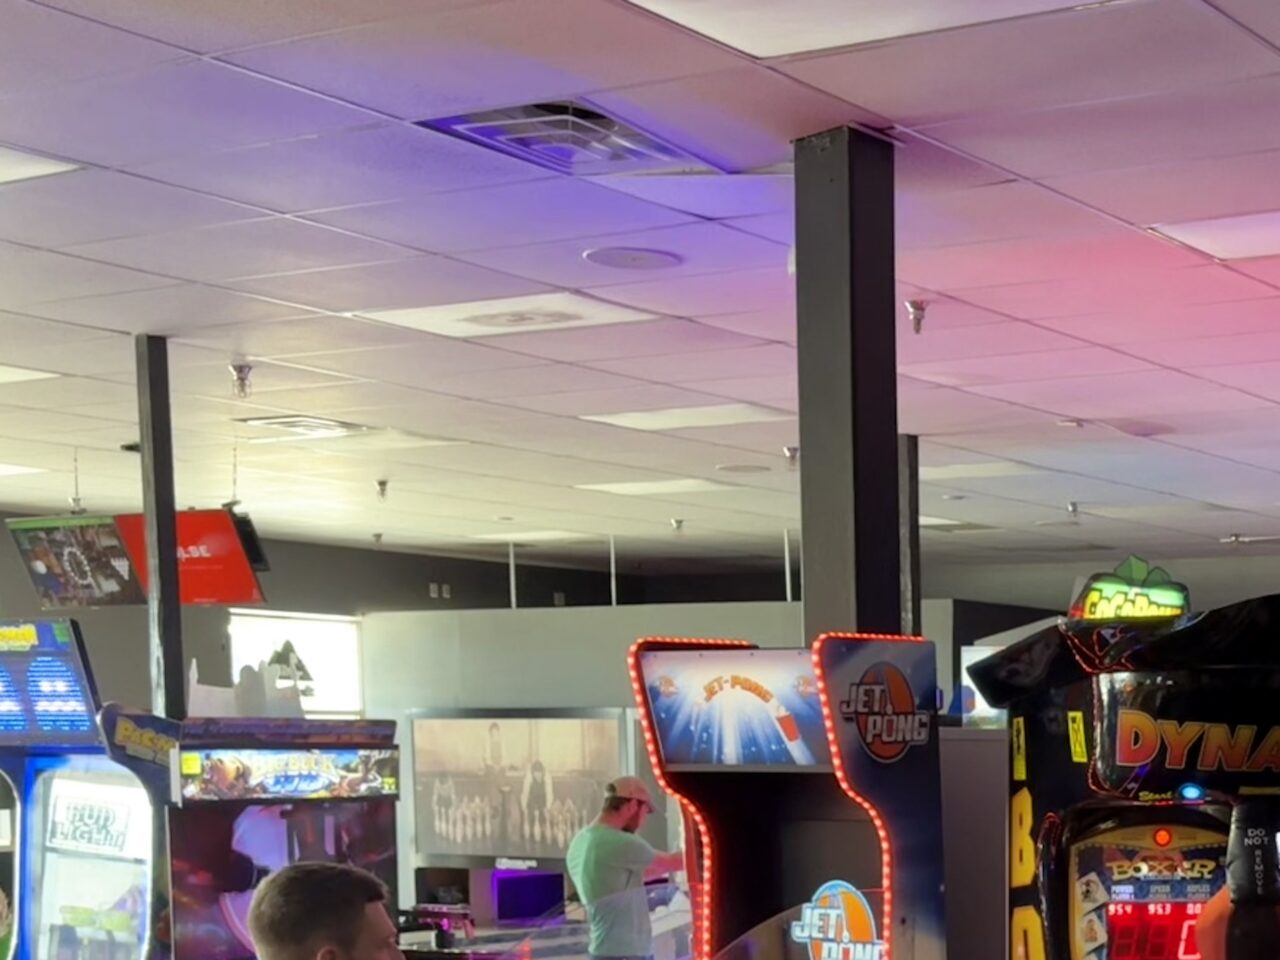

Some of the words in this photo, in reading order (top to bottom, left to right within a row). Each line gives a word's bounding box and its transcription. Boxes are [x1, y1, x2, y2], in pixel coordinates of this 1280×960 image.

[841, 684, 885, 713] JET
[866, 714, 928, 743] PONG
[1244, 837, 1269, 847] NOT
[1247, 828, 1266, 837] DO
[793, 907, 841, 939] JET
